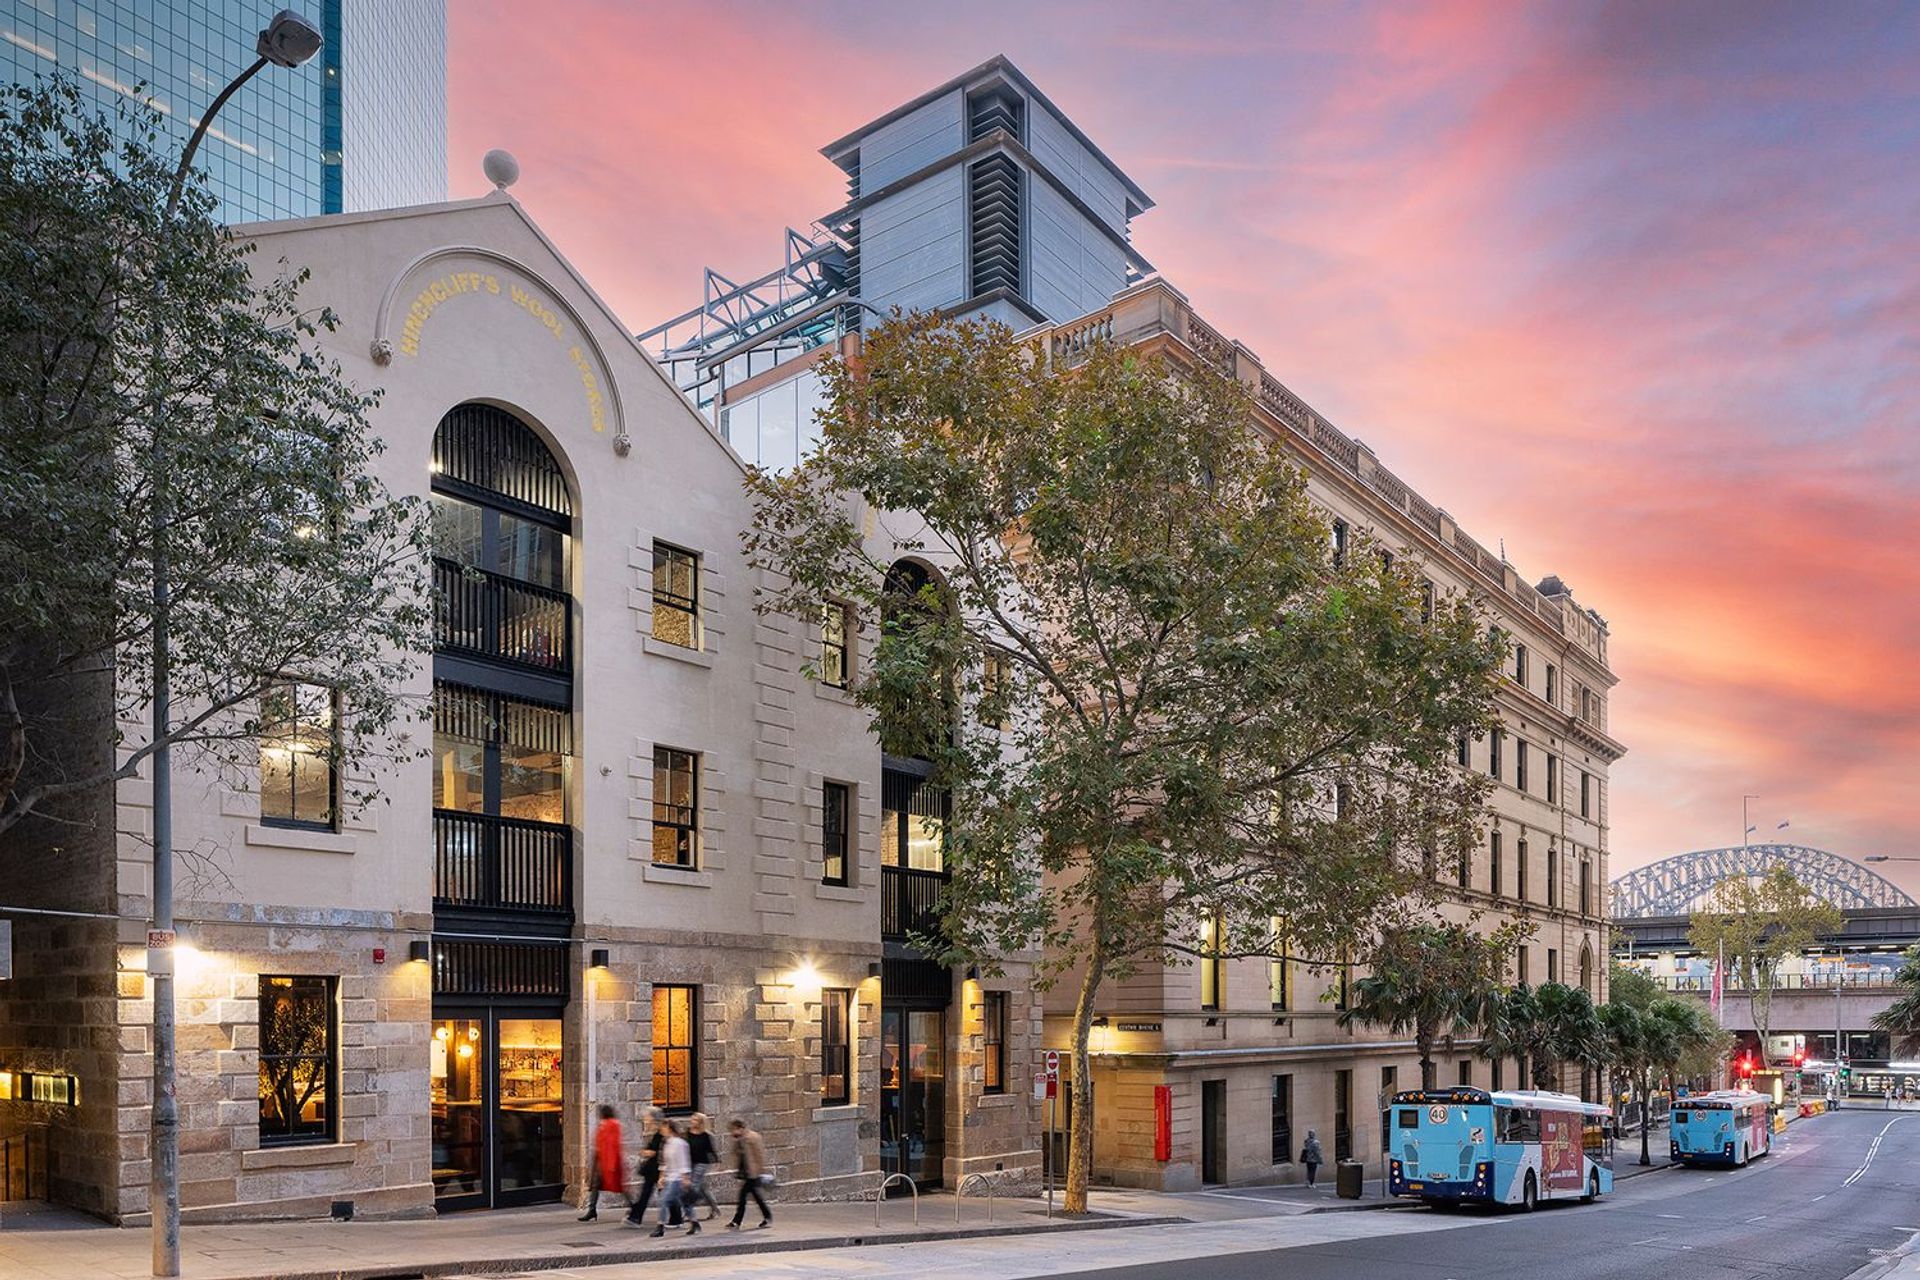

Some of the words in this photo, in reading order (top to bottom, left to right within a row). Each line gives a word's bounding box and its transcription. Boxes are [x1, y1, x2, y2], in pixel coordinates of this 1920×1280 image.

[401, 271, 501, 356] HINCHCLIFF'S
[511, 284, 564, 339] WOOL
[152, 932, 172, 940] BUS
[1432, 1109, 1446, 1119] 40
